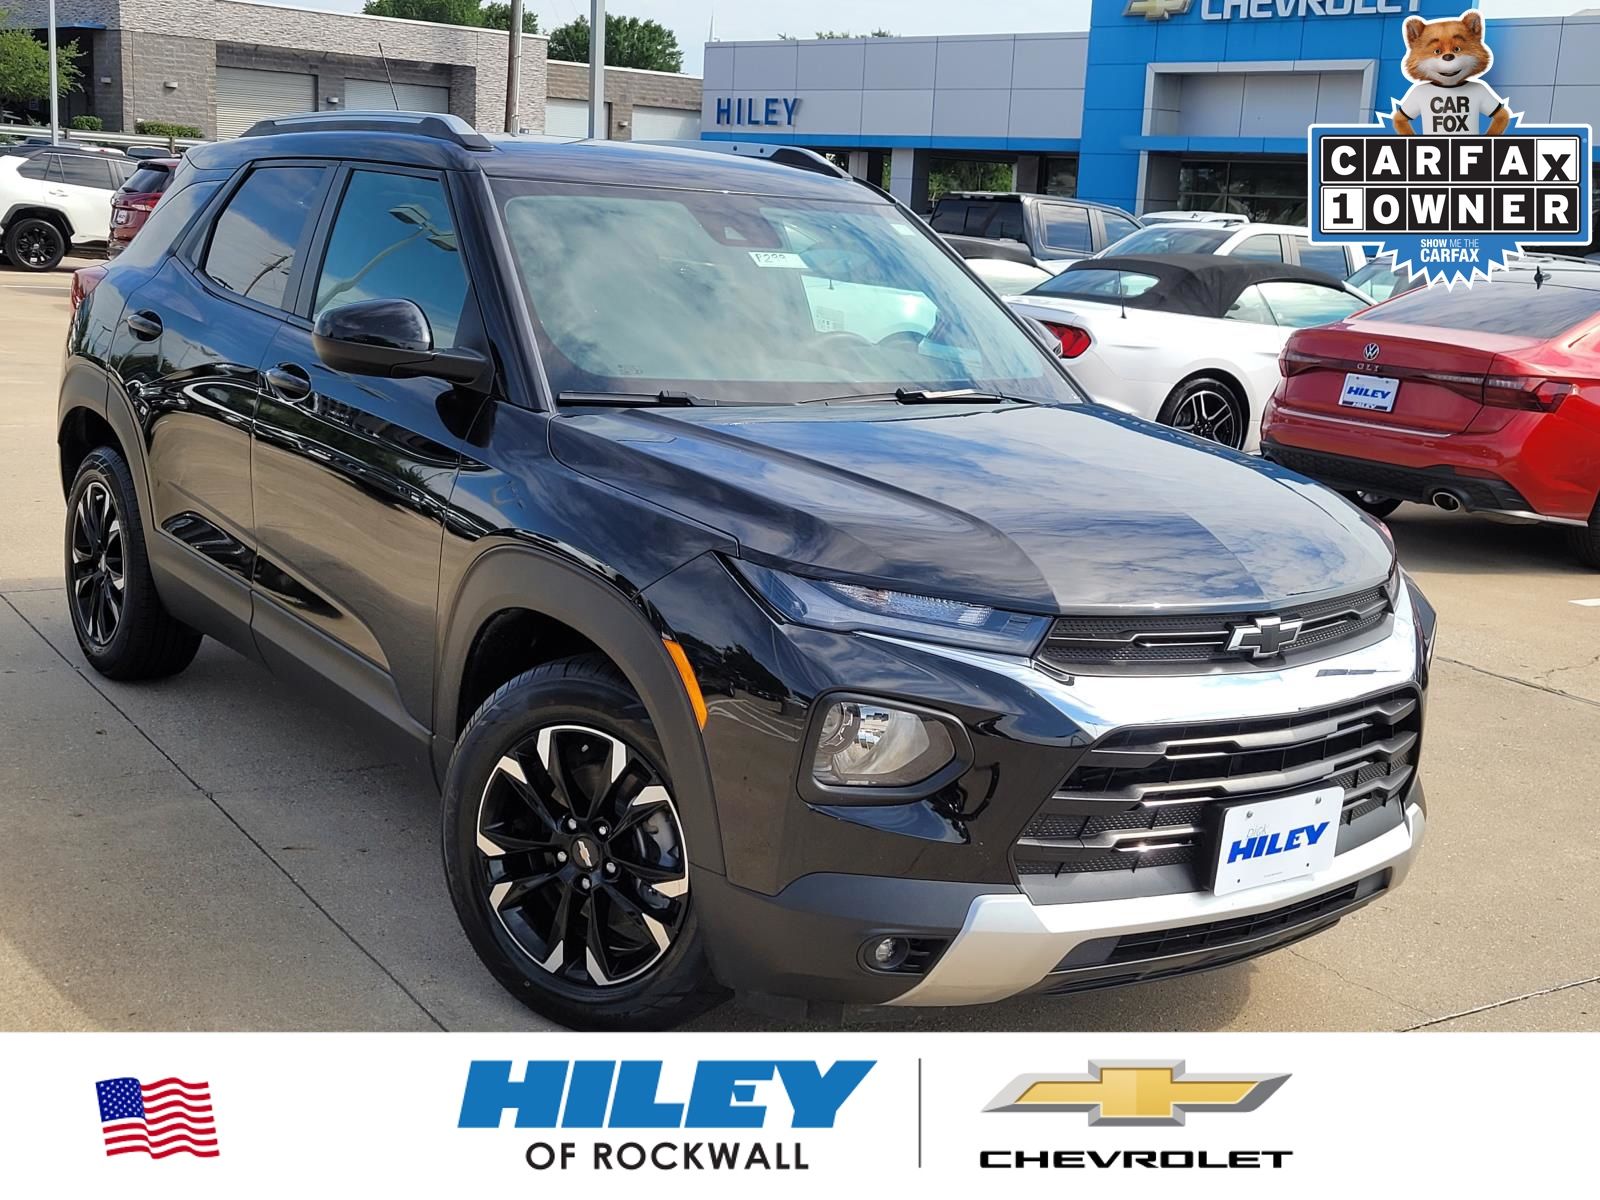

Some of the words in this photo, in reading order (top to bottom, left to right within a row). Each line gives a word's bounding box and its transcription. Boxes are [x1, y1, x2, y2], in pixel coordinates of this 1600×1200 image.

[716, 97, 800, 126] HILEY
[1346, 386, 1391, 400] HILEY
[1226, 821, 1331, 865] HILEY
